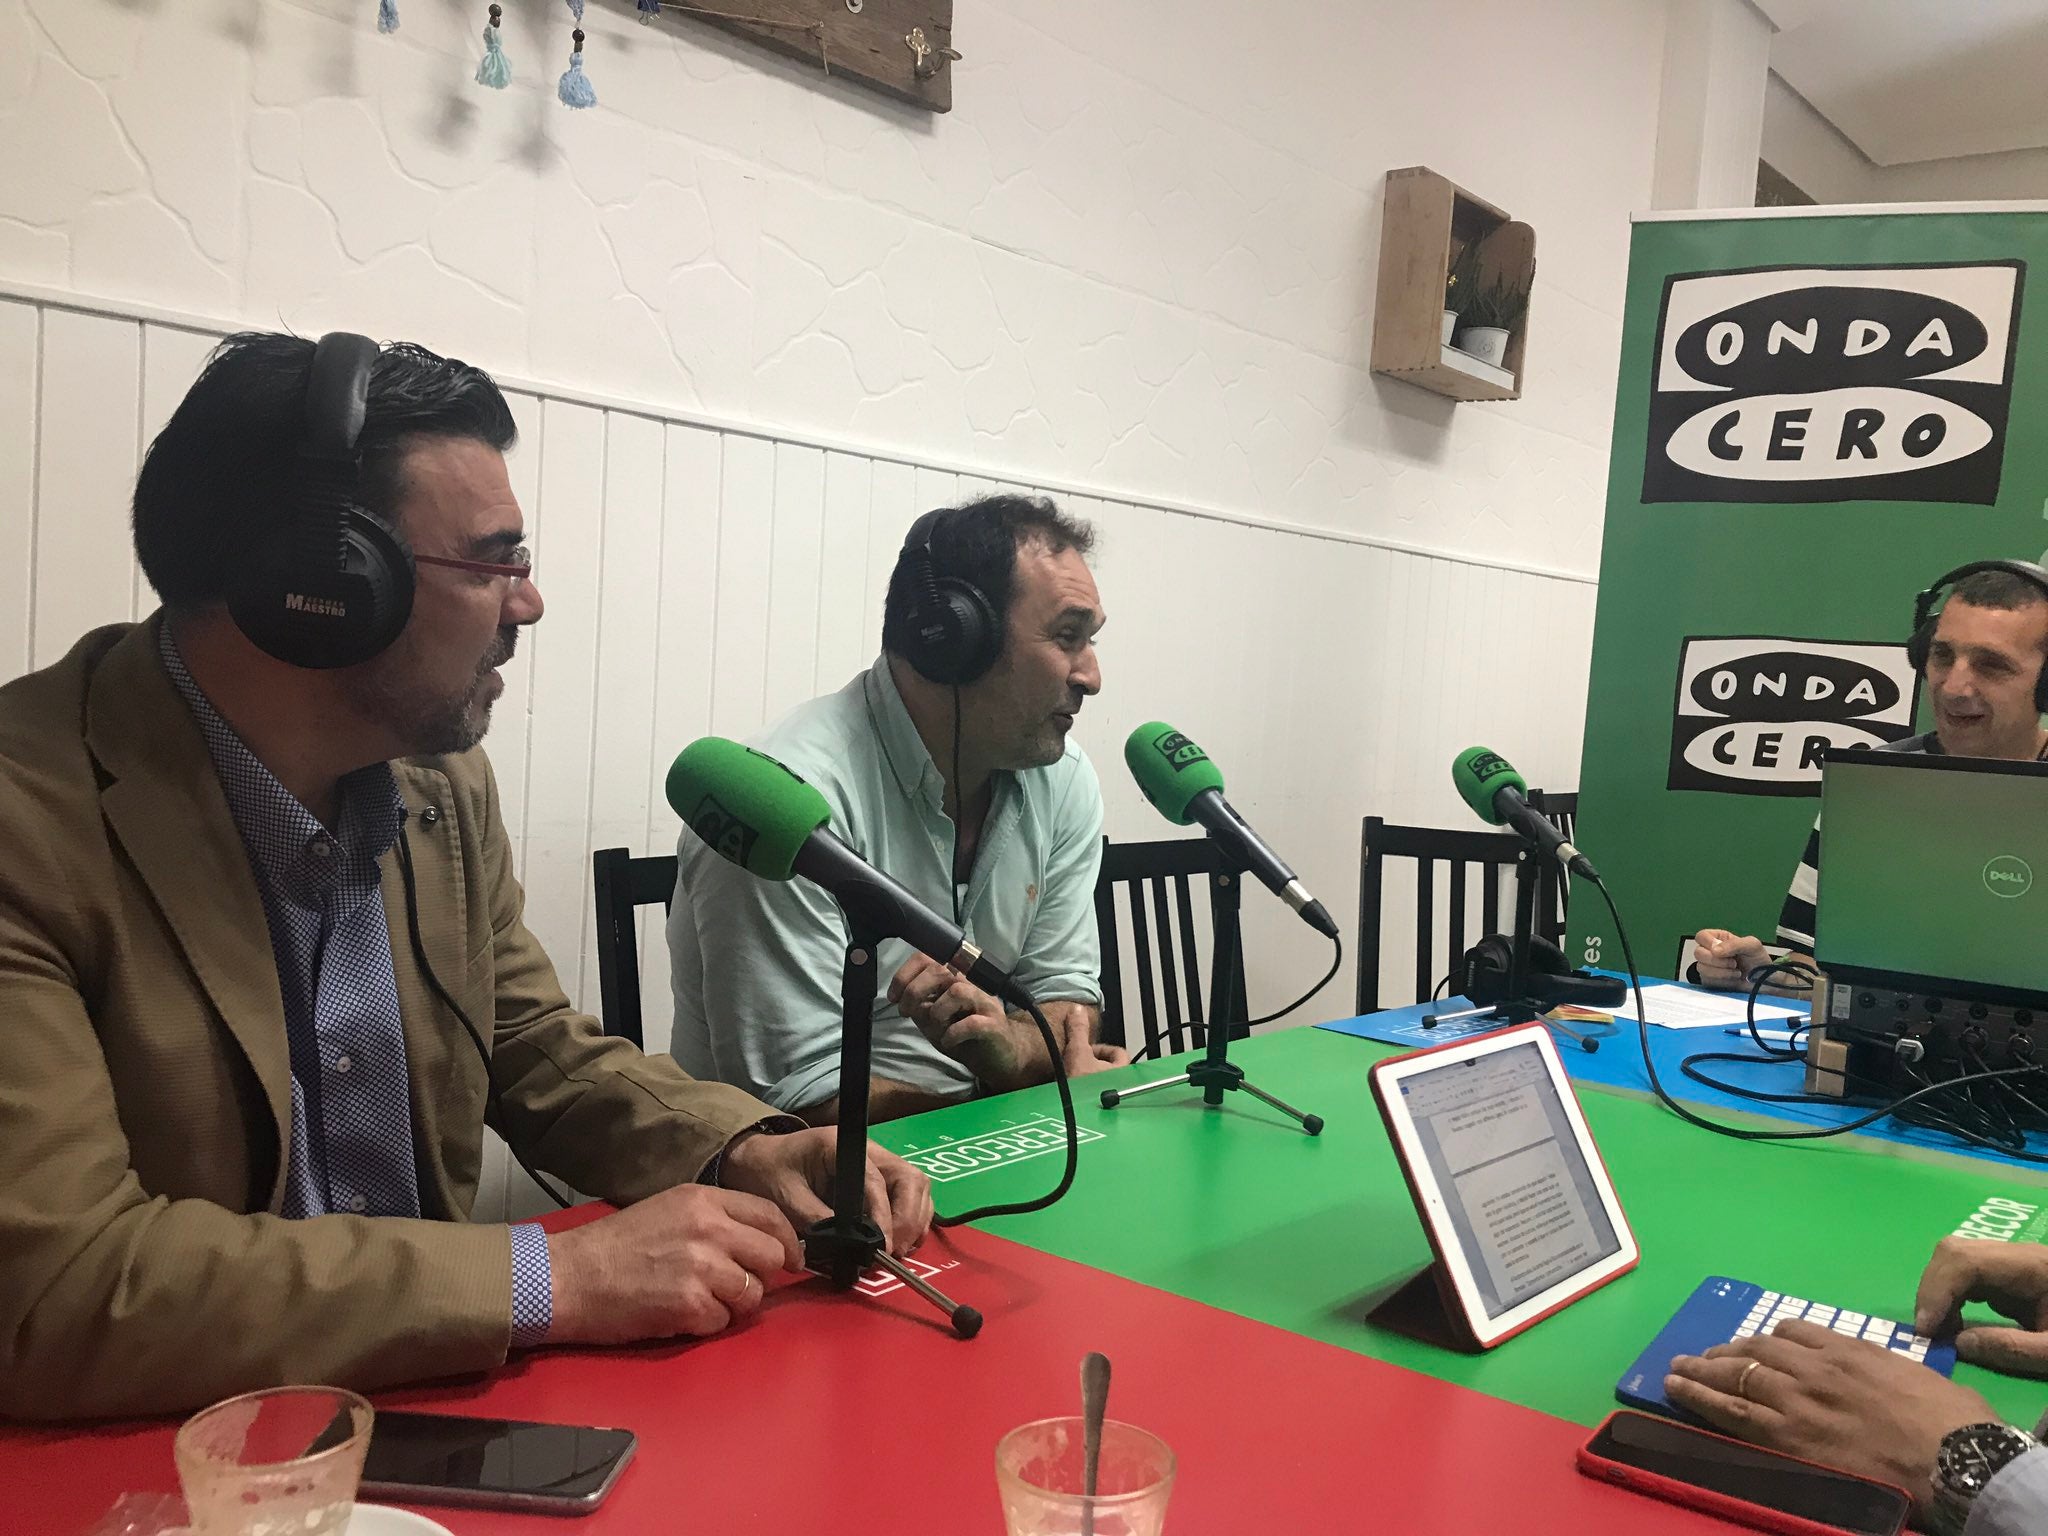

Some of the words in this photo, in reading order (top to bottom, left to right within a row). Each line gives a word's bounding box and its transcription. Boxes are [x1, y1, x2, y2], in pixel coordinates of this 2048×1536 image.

[1706, 318, 1954, 366] ONDA
[1707, 407, 1947, 461] CERO
[1711, 670, 1877, 706] ONDA
[1712, 730, 1871, 770] CER
[1990, 870, 2025, 883] DELL
[1950, 1197, 2039, 1242] RECOR
